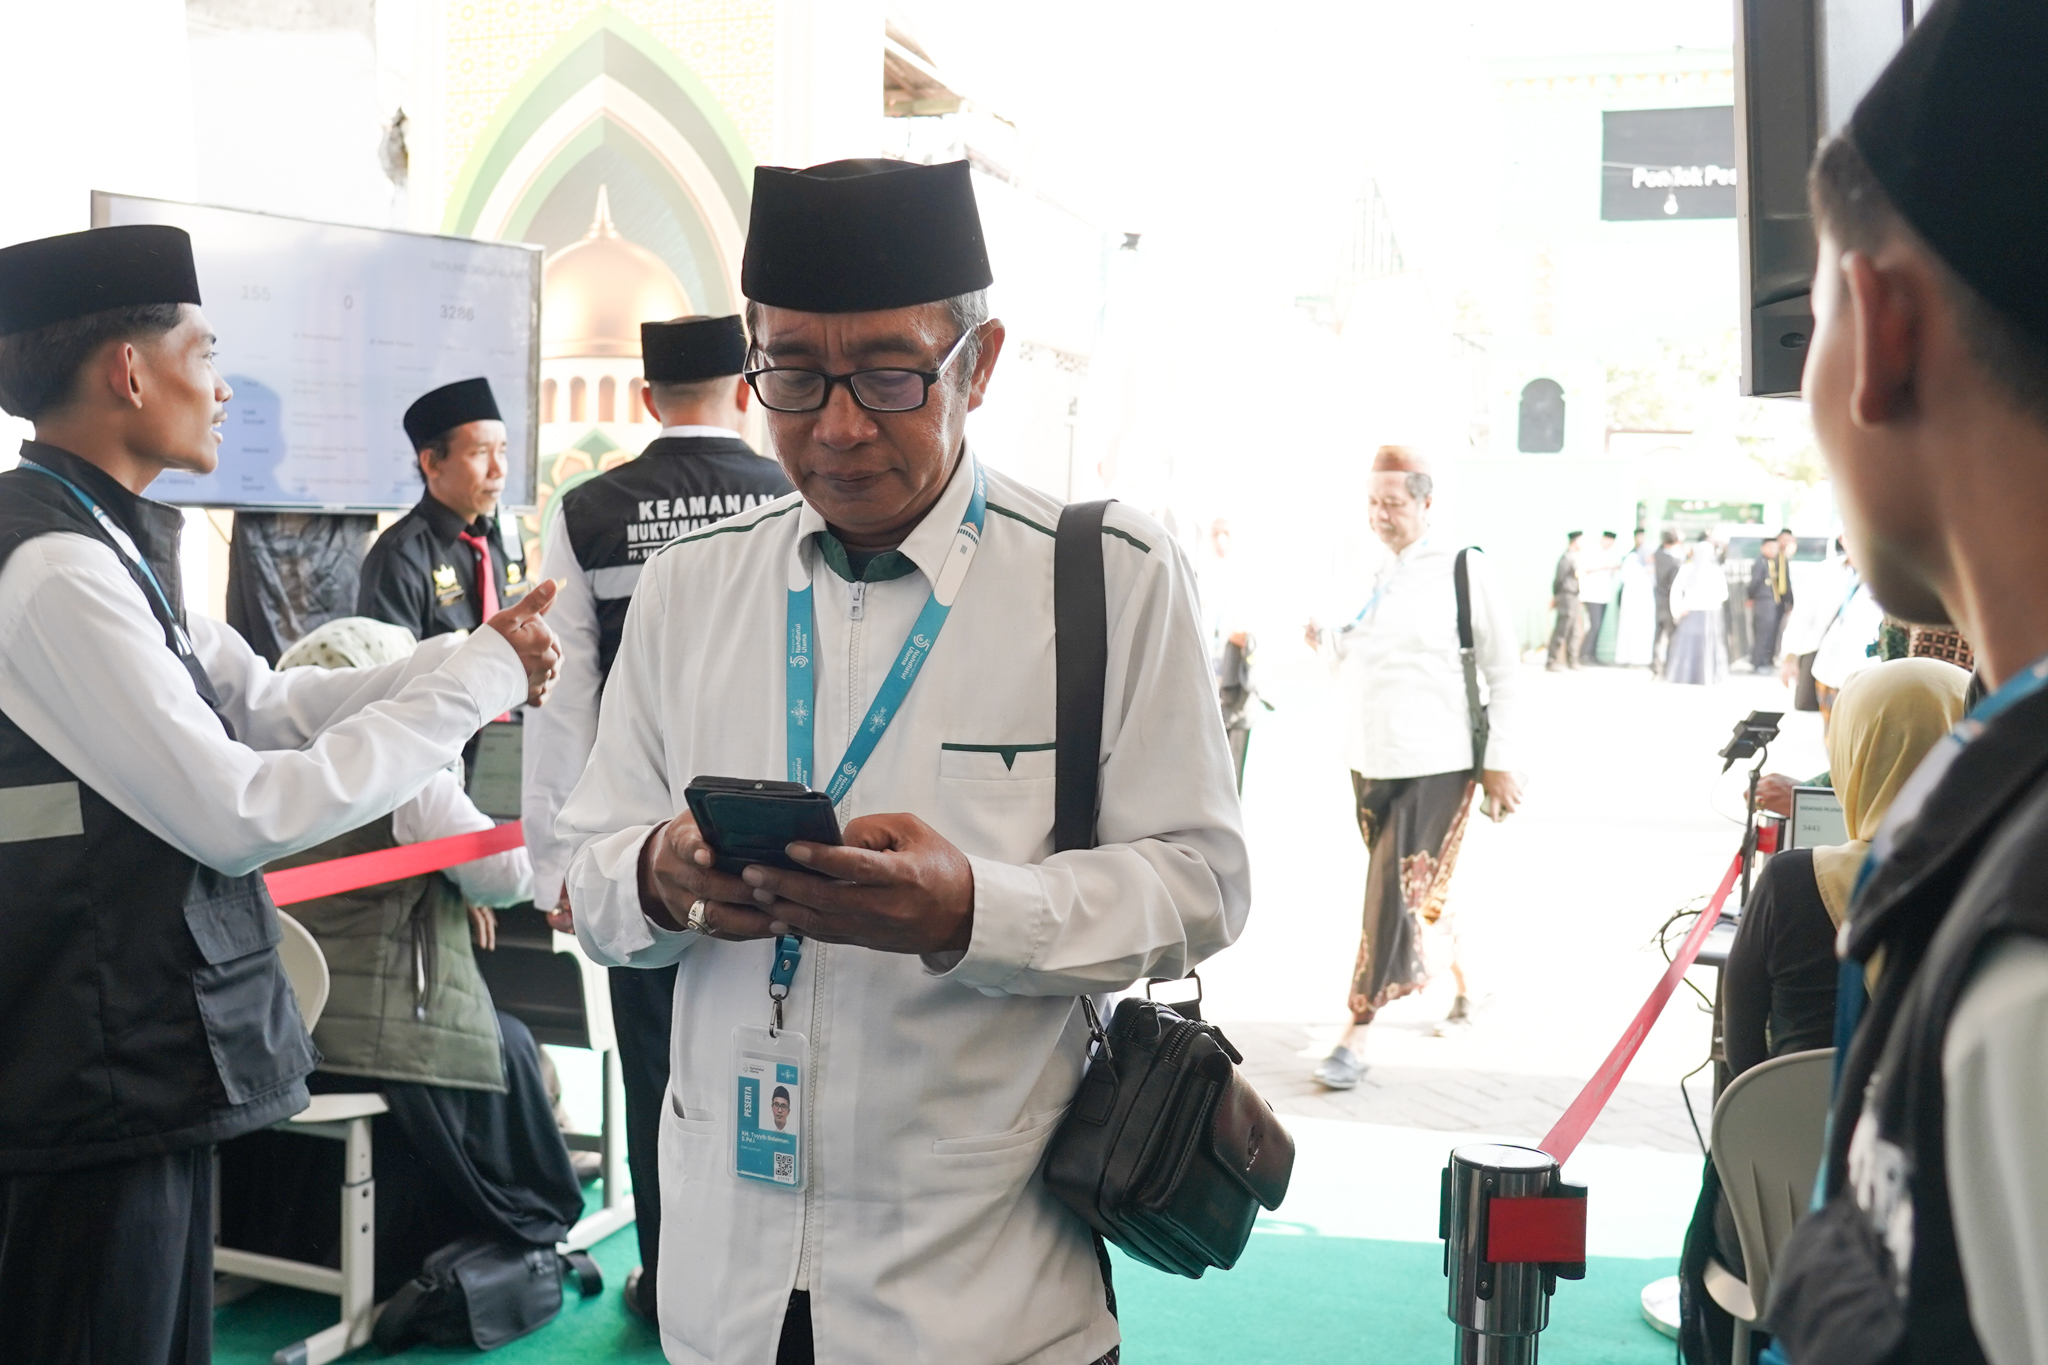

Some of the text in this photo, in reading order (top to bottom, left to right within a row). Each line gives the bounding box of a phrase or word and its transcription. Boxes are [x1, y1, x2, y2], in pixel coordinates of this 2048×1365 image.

[241, 284, 271, 302] 155
[343, 294, 353, 310] 0
[900, 649, 920, 680] Nahdlatul
[901, 646, 915, 666] Ulama
[830, 774, 844, 794] Ulama
[743, 1086, 753, 1118] PESERTA
